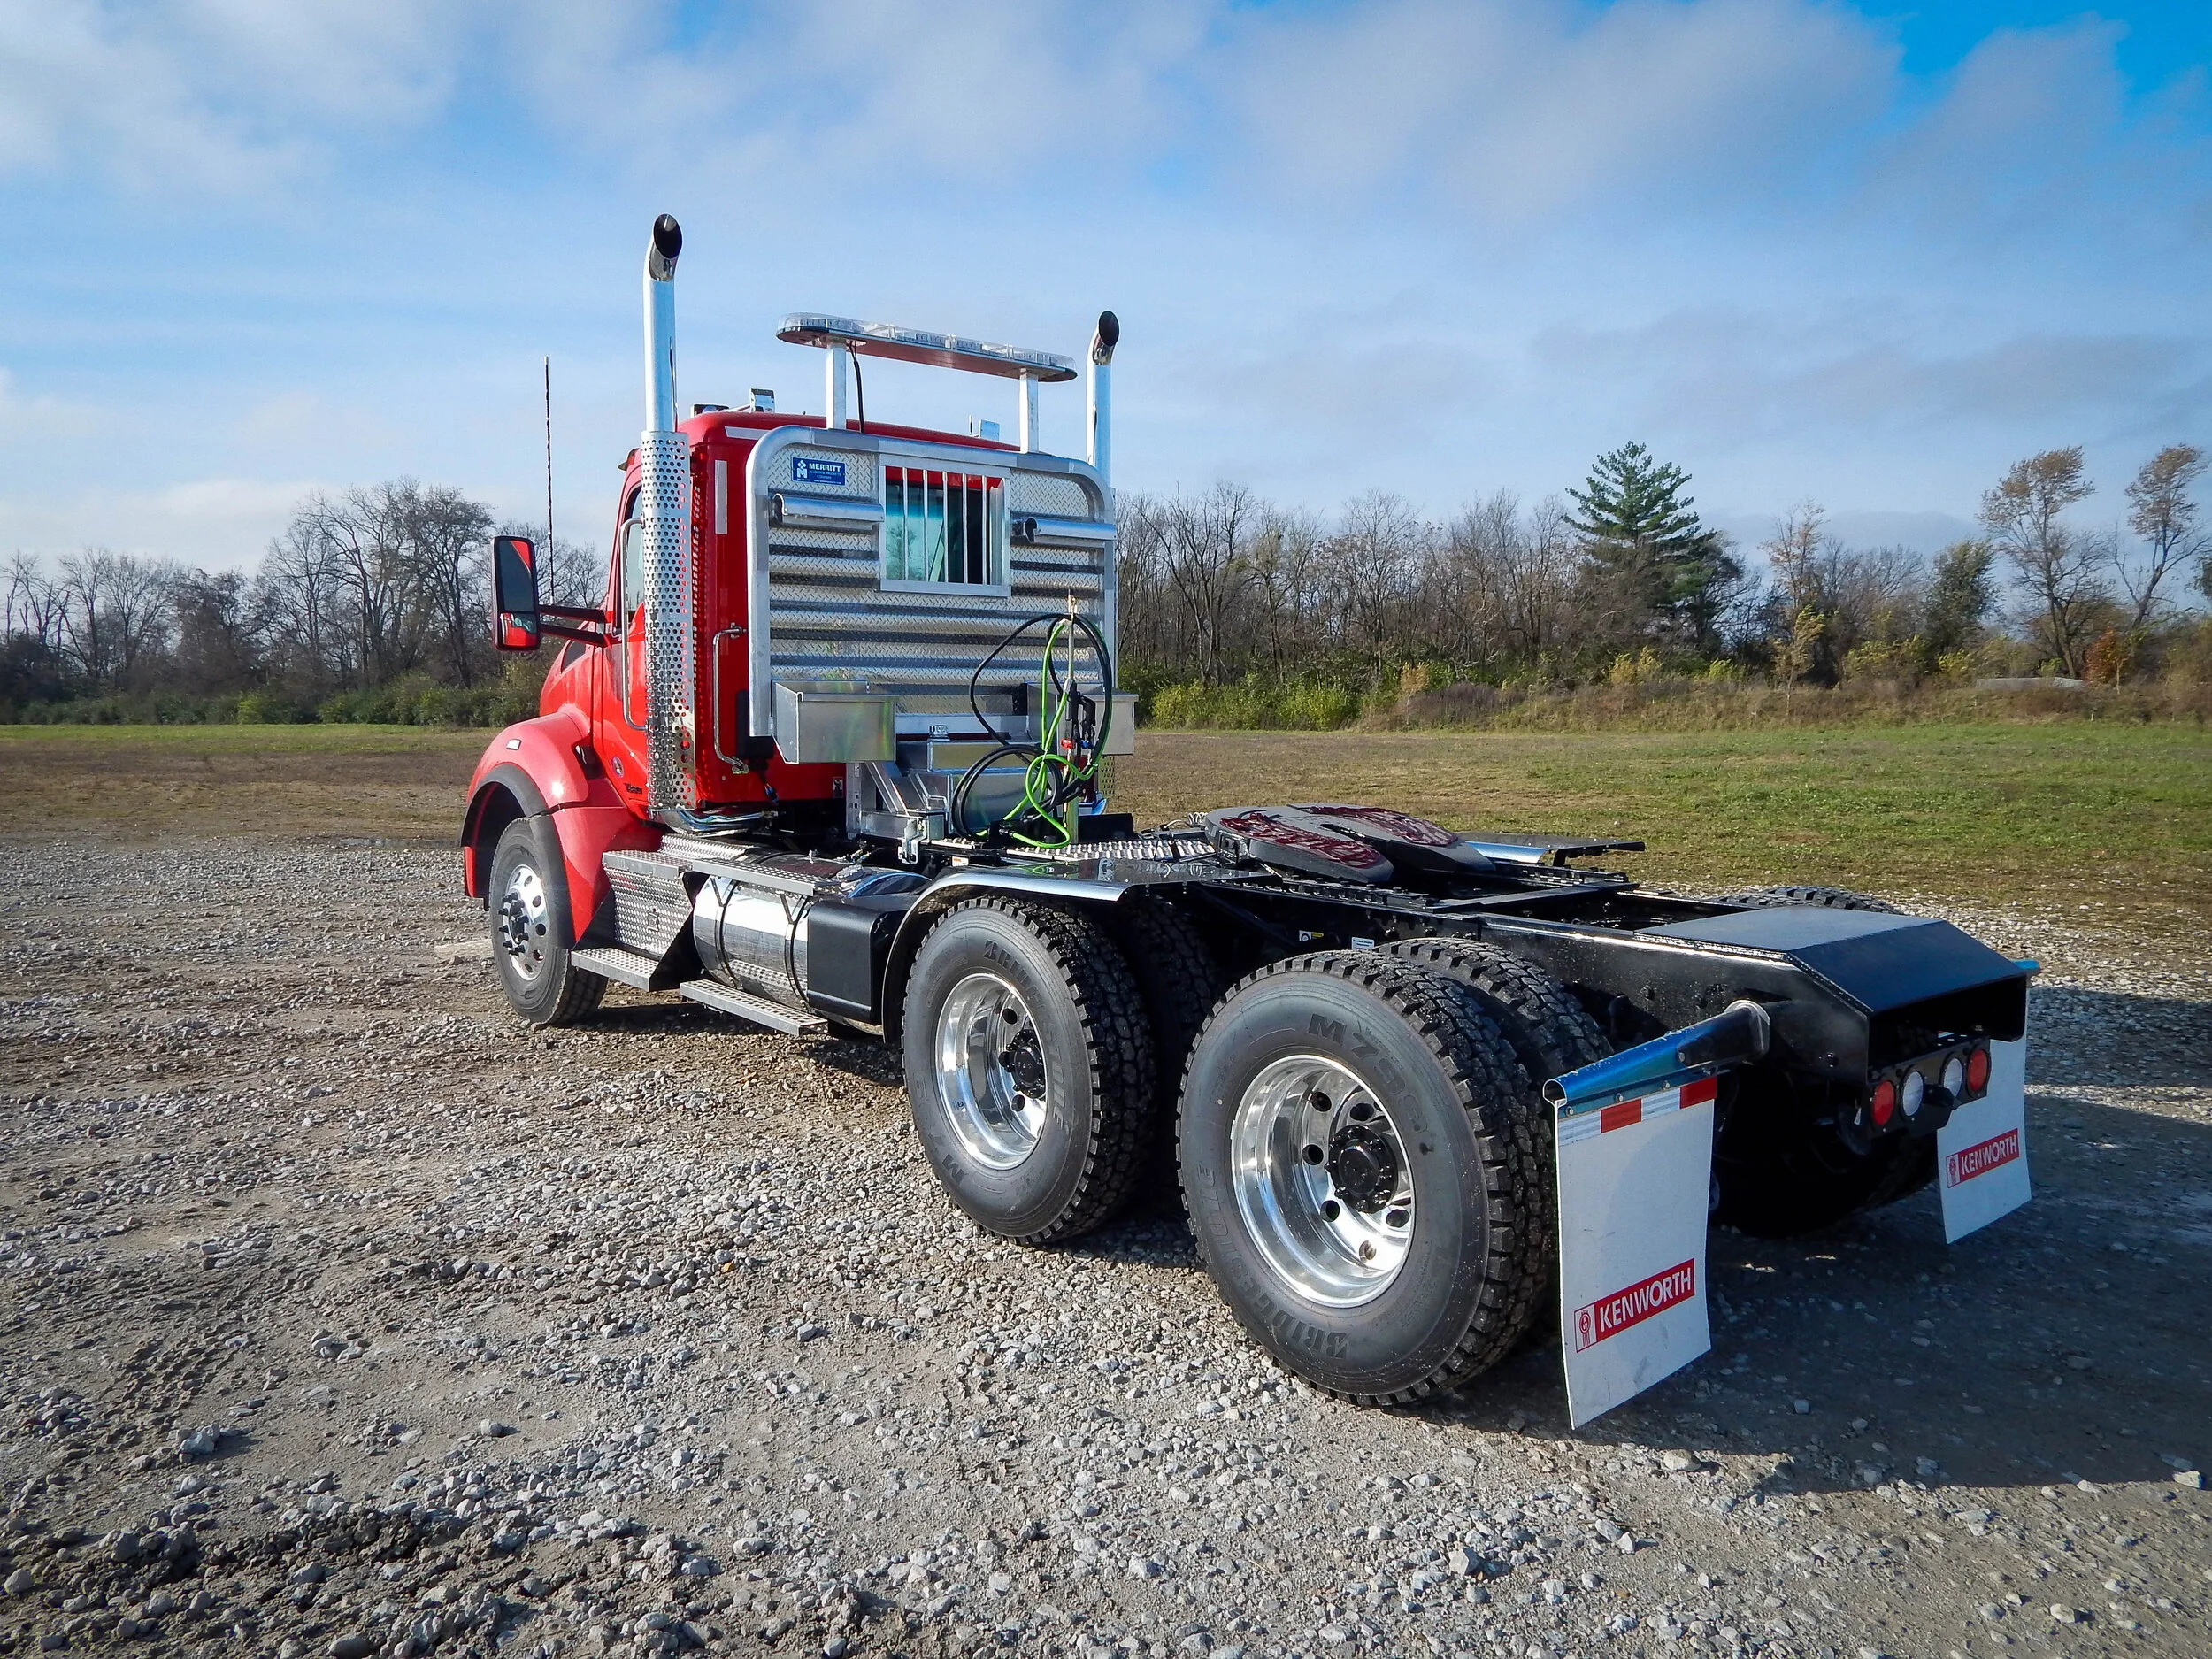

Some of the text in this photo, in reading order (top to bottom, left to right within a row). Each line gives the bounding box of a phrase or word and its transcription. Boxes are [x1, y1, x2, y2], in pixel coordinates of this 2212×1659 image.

[809, 463, 841, 472] MERRITT
[1962, 1134, 2016, 1175] KENWORTH
[1599, 1267, 1691, 1332] KENWORTH
